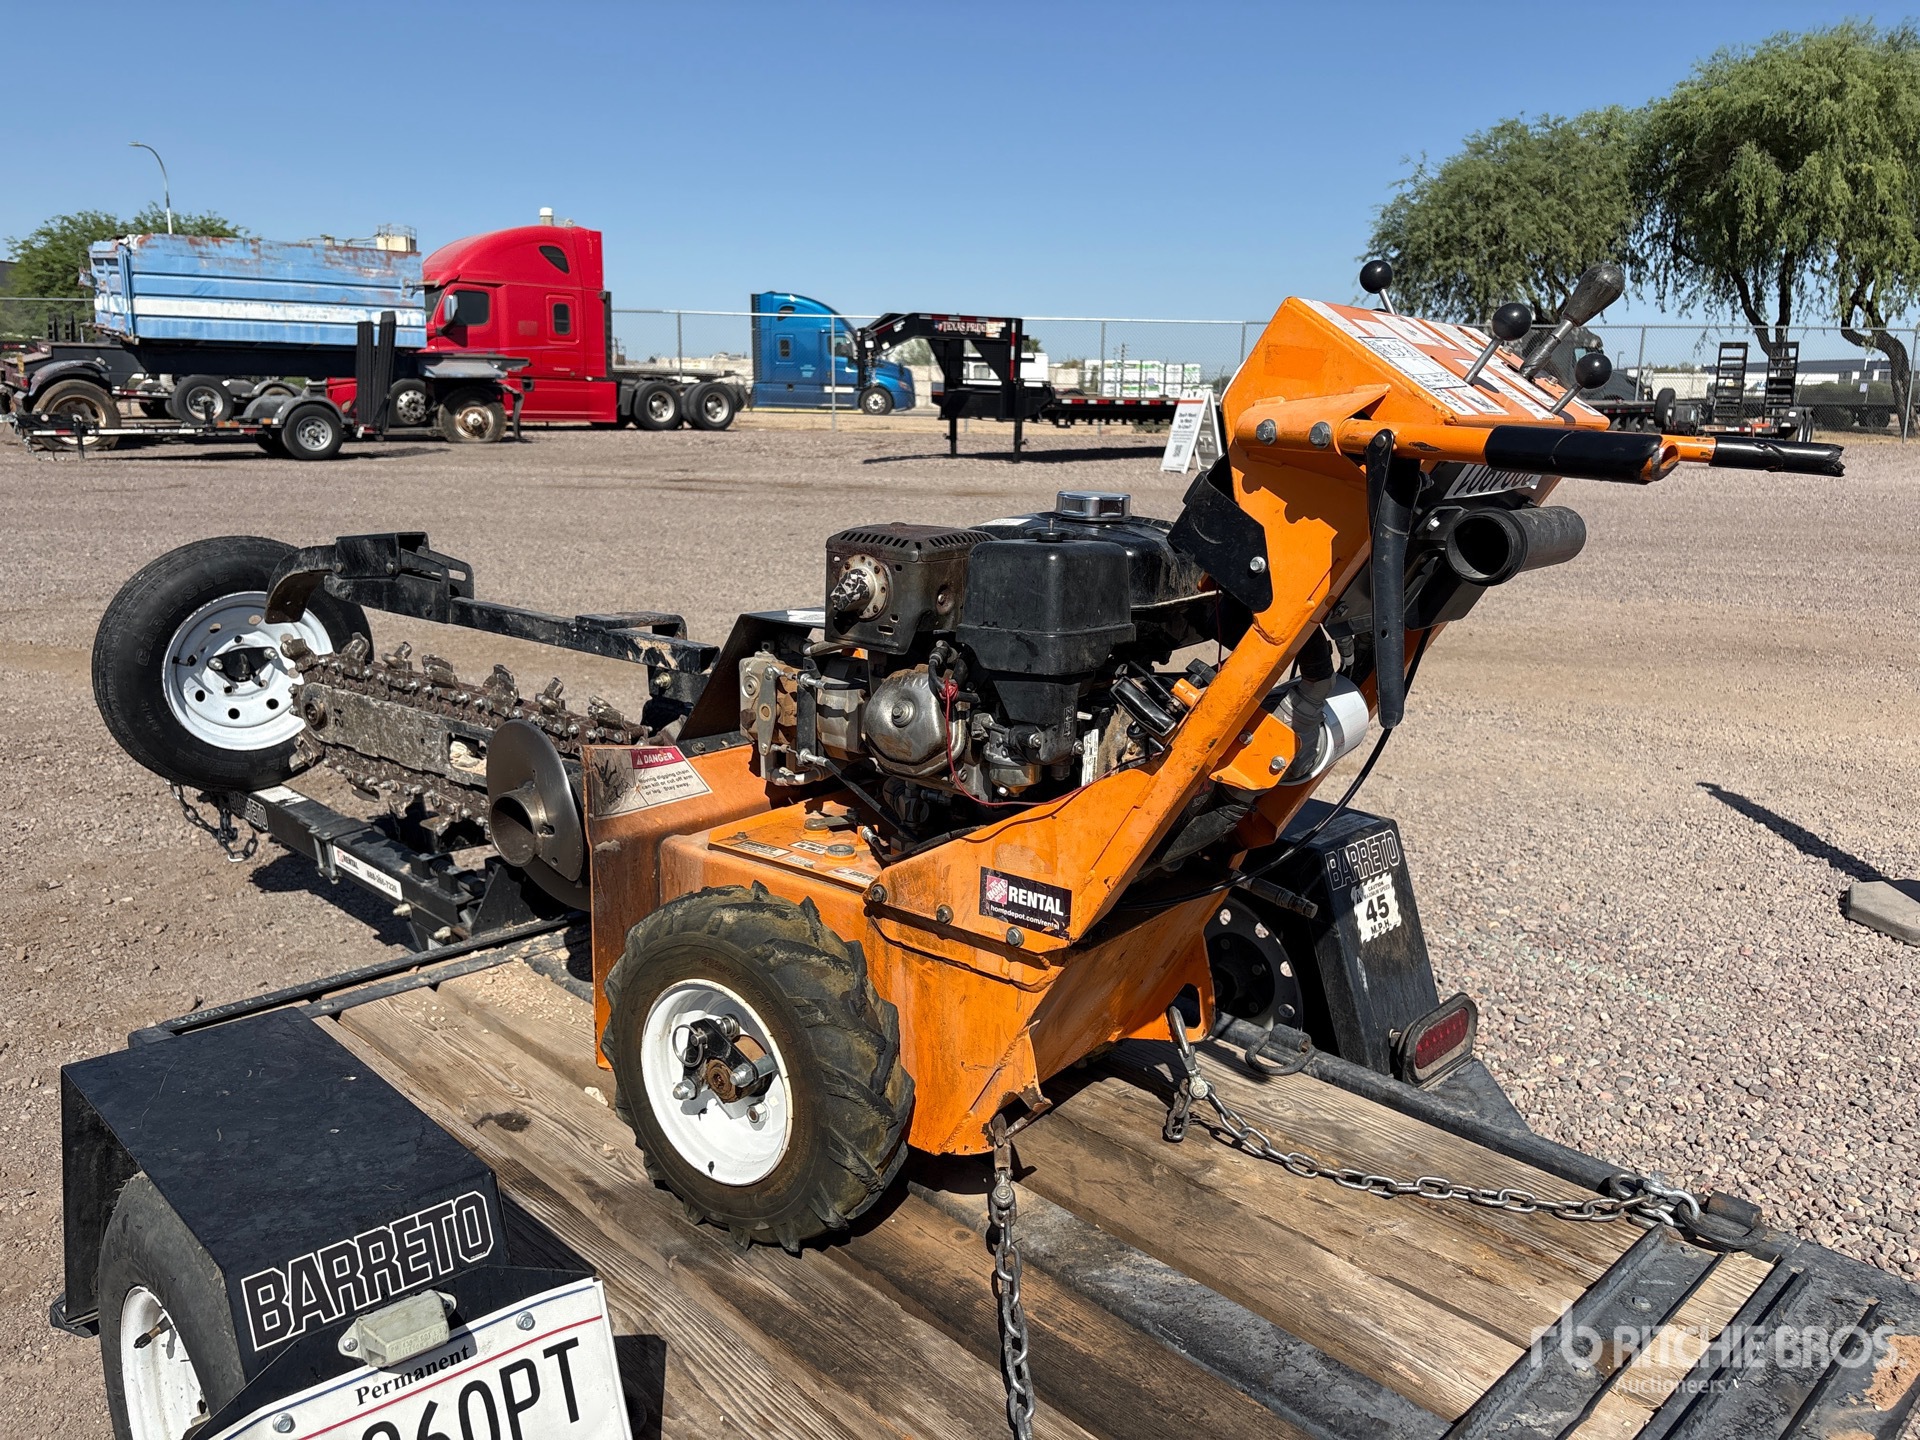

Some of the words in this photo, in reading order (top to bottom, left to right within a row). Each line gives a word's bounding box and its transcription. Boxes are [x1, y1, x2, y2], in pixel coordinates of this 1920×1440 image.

[942, 321, 965, 333] TEXAS
[643, 752, 675, 764] DANGER
[657, 772, 676, 780] digging
[1325, 829, 1400, 891] BARRETO
[987, 879, 1007, 901] HOME
[1367, 880, 1384, 892] CAUTION
[1008, 885, 1064, 916] RENTAL
[1366, 894, 1390, 922] 45
[1370, 919, 1392, 935] M.P.H.
[241, 1190, 494, 1352] BARRETO
[354, 1342, 471, 1407] Permanent
